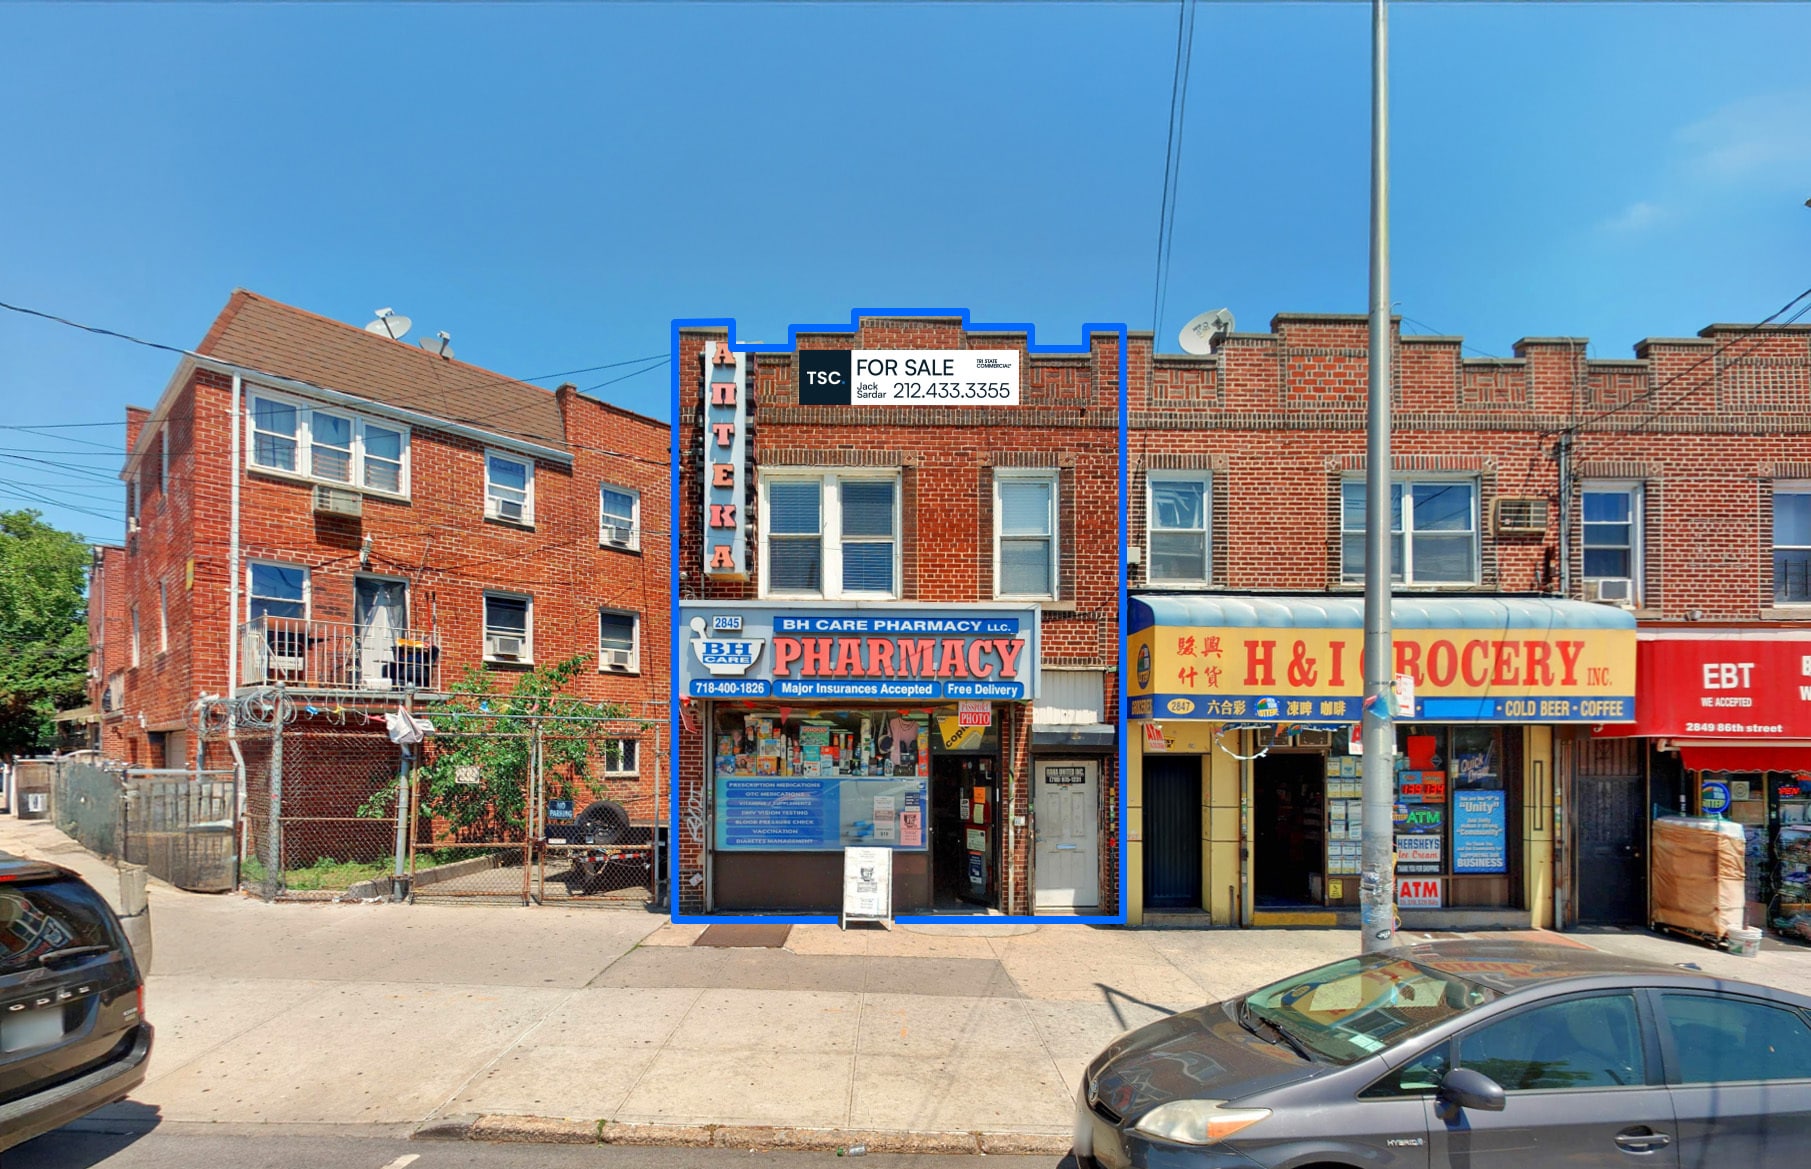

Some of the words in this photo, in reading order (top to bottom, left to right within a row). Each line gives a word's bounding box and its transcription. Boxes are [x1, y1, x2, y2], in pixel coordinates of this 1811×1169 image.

[715, 618, 740, 628] 2845
[783, 620, 810, 630] BH
[816, 620, 868, 631] CARE
[874, 620, 982, 632] PHARMACY
[702, 642, 752, 656] BH
[772, 637, 1025, 678] PHARMACY
[1360, 640, 1585, 688] ROCERY
[1587, 668, 1612, 686] INC.
[1178, 666, 1222, 688] 什貨
[1702, 662, 1755, 690] EBT
[696, 682, 764, 694] 718-400-1826
[782, 682, 813, 696] Major
[816, 683, 878, 694] Insurances
[881, 684, 932, 696] Accepted
[948, 684, 972, 694] Free
[976, 684, 1018, 696] Delivery
[1172, 702, 1190, 711] 2847
[1207, 700, 1246, 715] 六合彩
[1320, 701, 1346, 716] 咖啡
[1505, 700, 1536, 716] COLD
[1540, 700, 1570, 716] BEER
[1580, 700, 1624, 716] COFFEE
[1701, 697, 1714, 708] WE
[1715, 697, 1752, 708] ACCEPTED
[961, 712, 990, 724] PHOTO
[1686, 722, 1716, 732] 2849
[1716, 722, 1744, 733] 86th
[1746, 723, 1783, 733] street
[1406, 811, 1440, 824] ATM
[1398, 850, 1408, 858] Ice
[1412, 850, 1438, 858] Cream
[1457, 858, 1503, 867] BUSINESS
[1400, 882, 1438, 898] ATM
